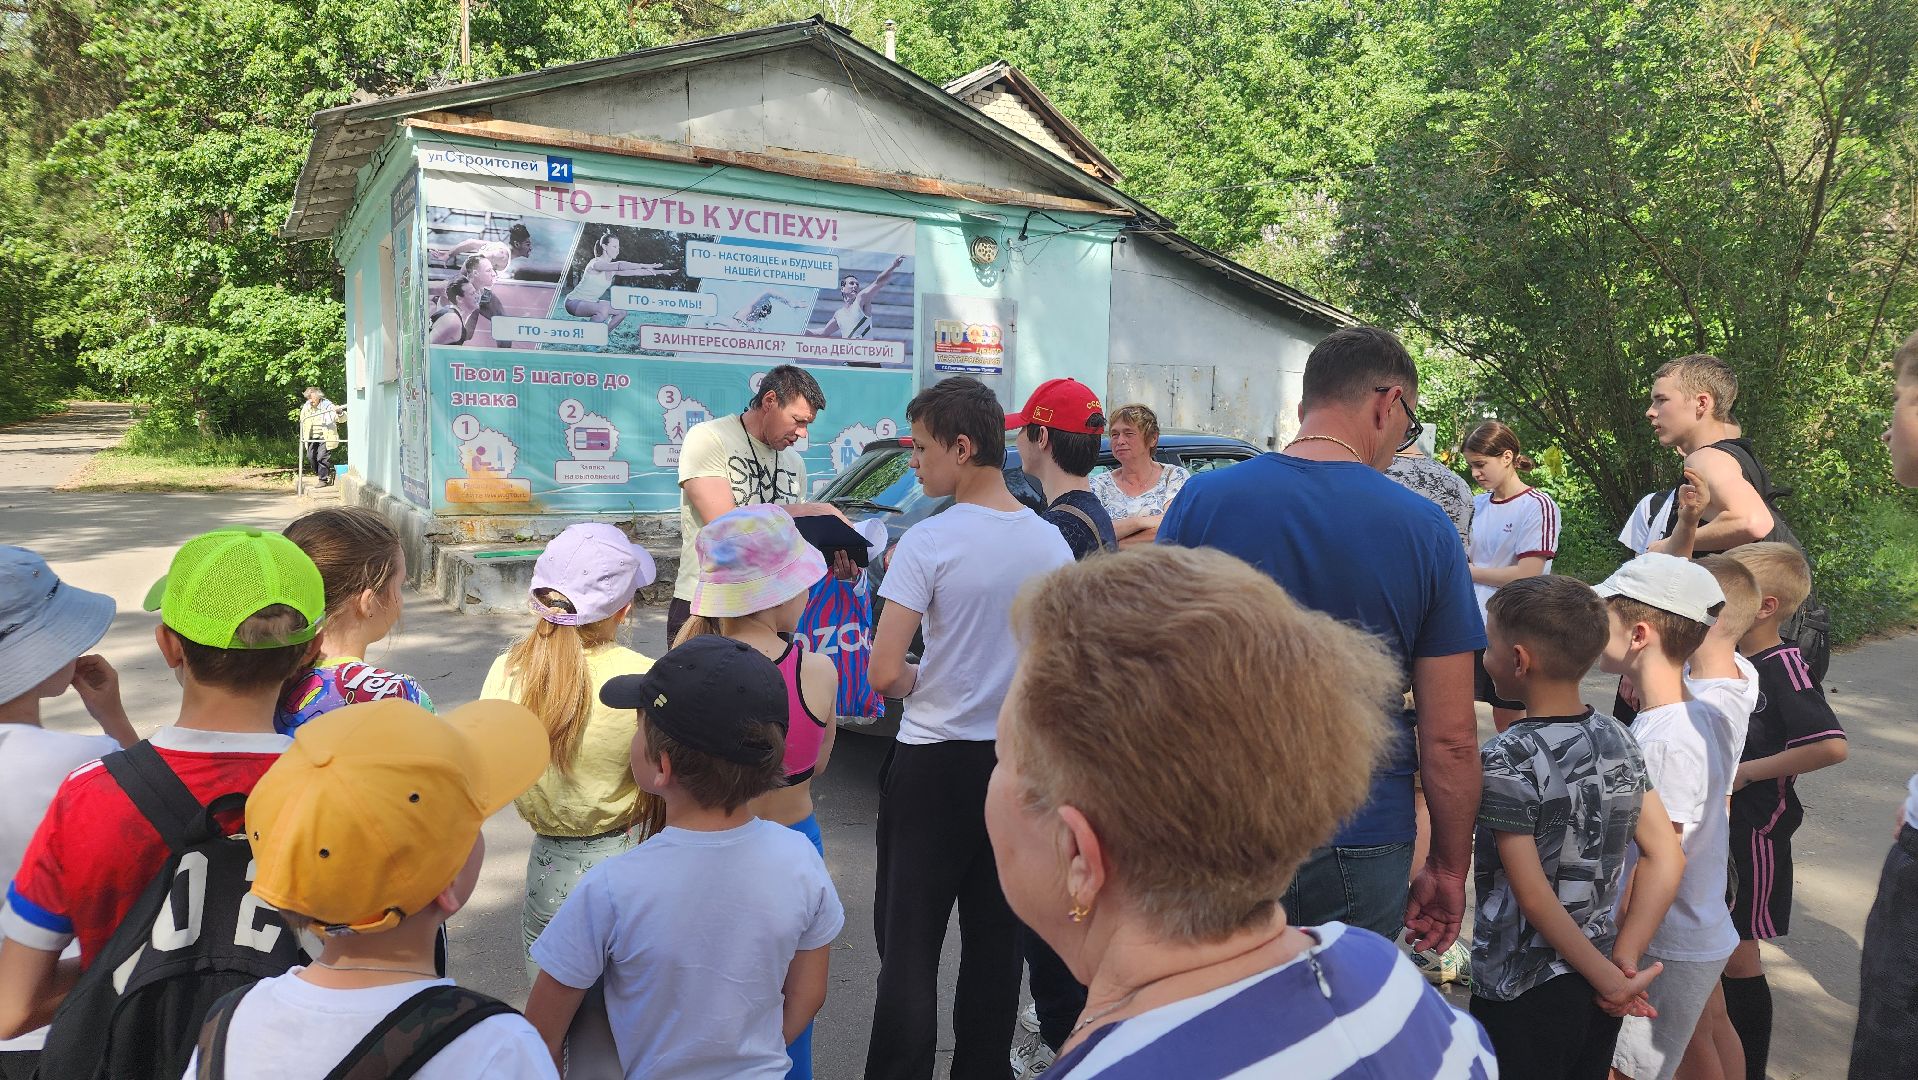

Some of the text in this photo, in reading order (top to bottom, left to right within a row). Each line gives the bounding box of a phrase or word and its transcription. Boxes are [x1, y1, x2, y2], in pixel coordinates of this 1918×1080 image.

[551, 163, 568, 177] 21
[535, 186, 592, 214] ГТО
[618, 194, 695, 225] ПУТЬ
[703, 204, 721, 229] К
[726, 207, 838, 242] УСПЕХУ!
[691, 248, 711, 259] ГТО
[718, 251, 779, 266] НАСТОЯЩЕЕ
[789, 257, 833, 271] БУДУЩЕЕ
[724, 265, 806, 282] НАШЕЙ СТРАНЫ!
[628, 294, 649, 306] ГТО
[658, 299, 677, 308] это
[678, 299, 702, 310] МЫ!
[518, 325, 541, 336] ГТО
[550, 329, 570, 338] это
[572, 328, 584, 339] Я!
[653, 332, 894, 358] ЗАИНТЕРЕСОВАЛСЯ? Тогда ДЕЙСТВУЙ!
[450, 363, 630, 390] Твои 5 шагов до
[451, 392, 518, 408] знака
[665, 390, 675, 404] 3
[567, 404, 577, 419] 2
[461, 420, 470, 435] 1
[882, 423, 890, 436] 5
